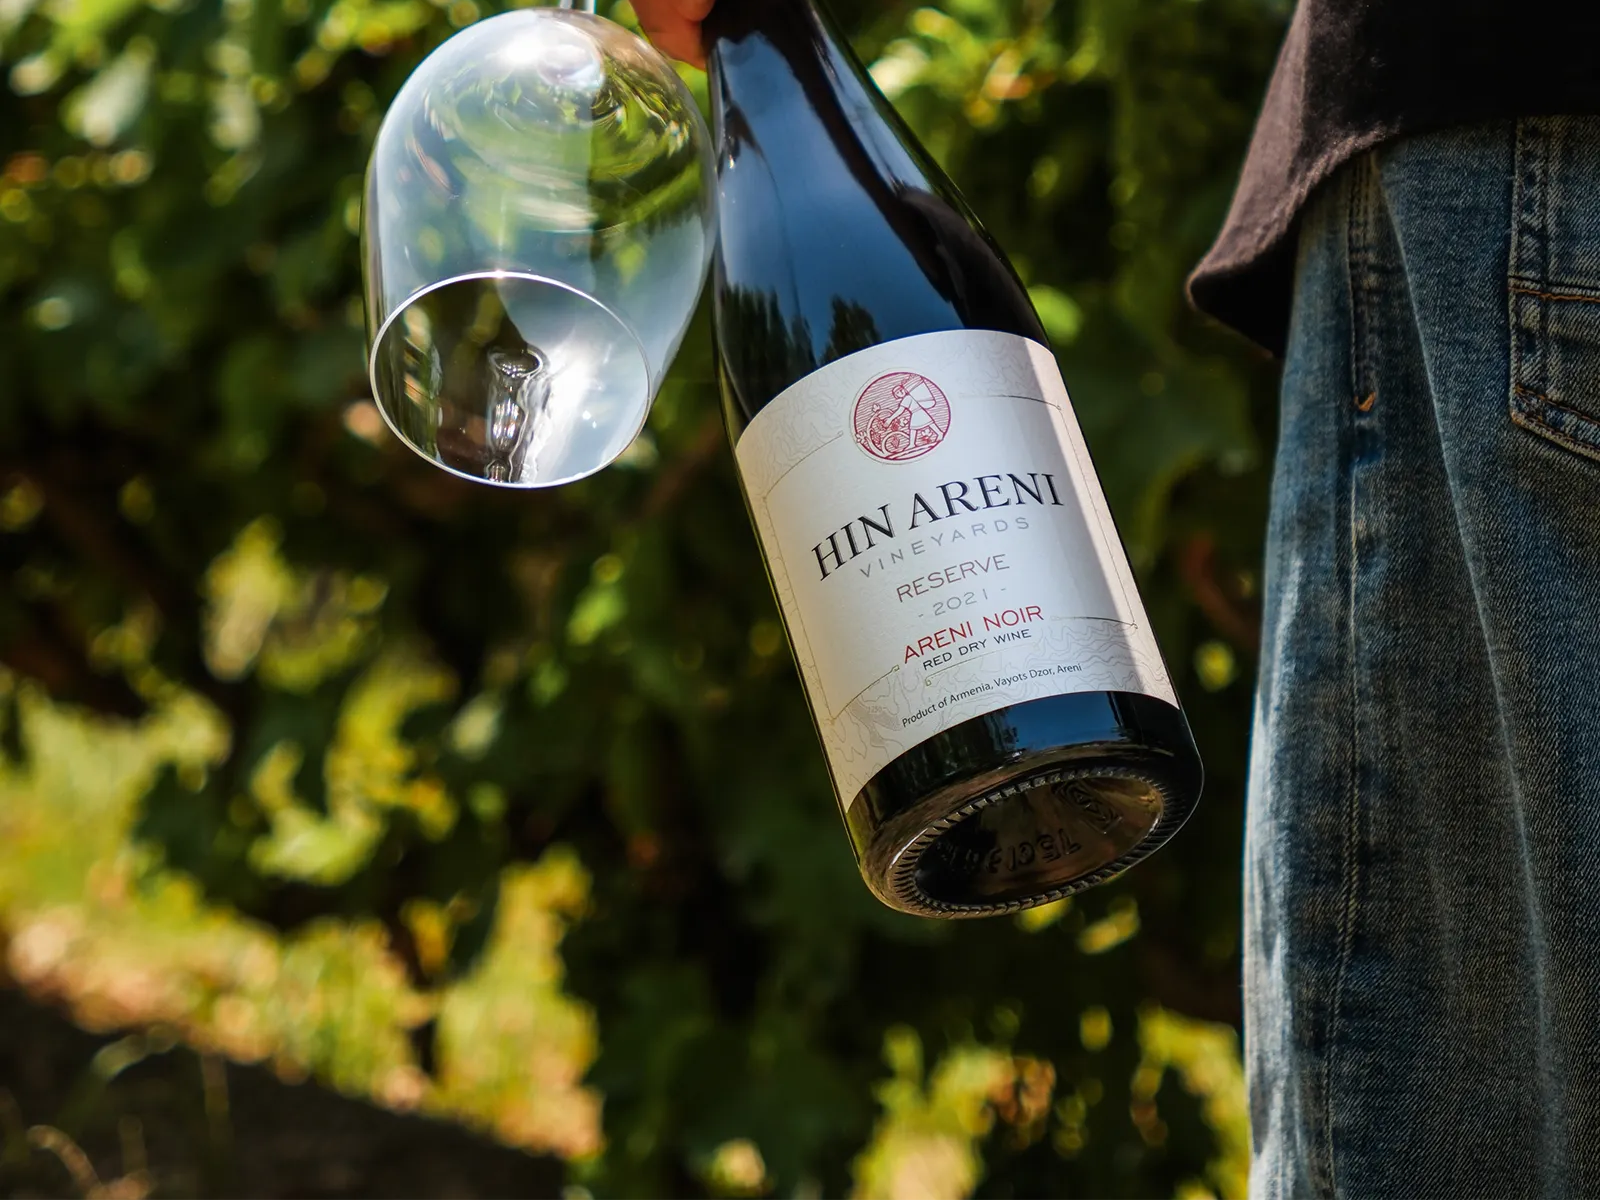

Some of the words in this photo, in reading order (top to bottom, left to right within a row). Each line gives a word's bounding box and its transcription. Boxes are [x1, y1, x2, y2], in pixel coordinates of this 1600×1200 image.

[811, 503, 896, 582] HIN
[908, 472, 1065, 531] ARENI
[859, 517, 1030, 578] VINEYARDS
[896, 553, 1010, 603] RESERVE
[932, 588, 988, 616] 2021
[904, 621, 974, 664] ARENI
[983, 605, 1044, 632] NOIR
[922, 652, 953, 670] RED
[958, 639, 987, 656] DRY
[993, 628, 1032, 645] WINE
[902, 704, 937, 728] Product
[938, 694, 948, 709] of
[949, 682, 994, 704] Armenia,
[994, 672, 1028, 689] Vayots
[1029, 666, 1056, 679] Dzor,
[1057, 663, 1082, 674] Areni
